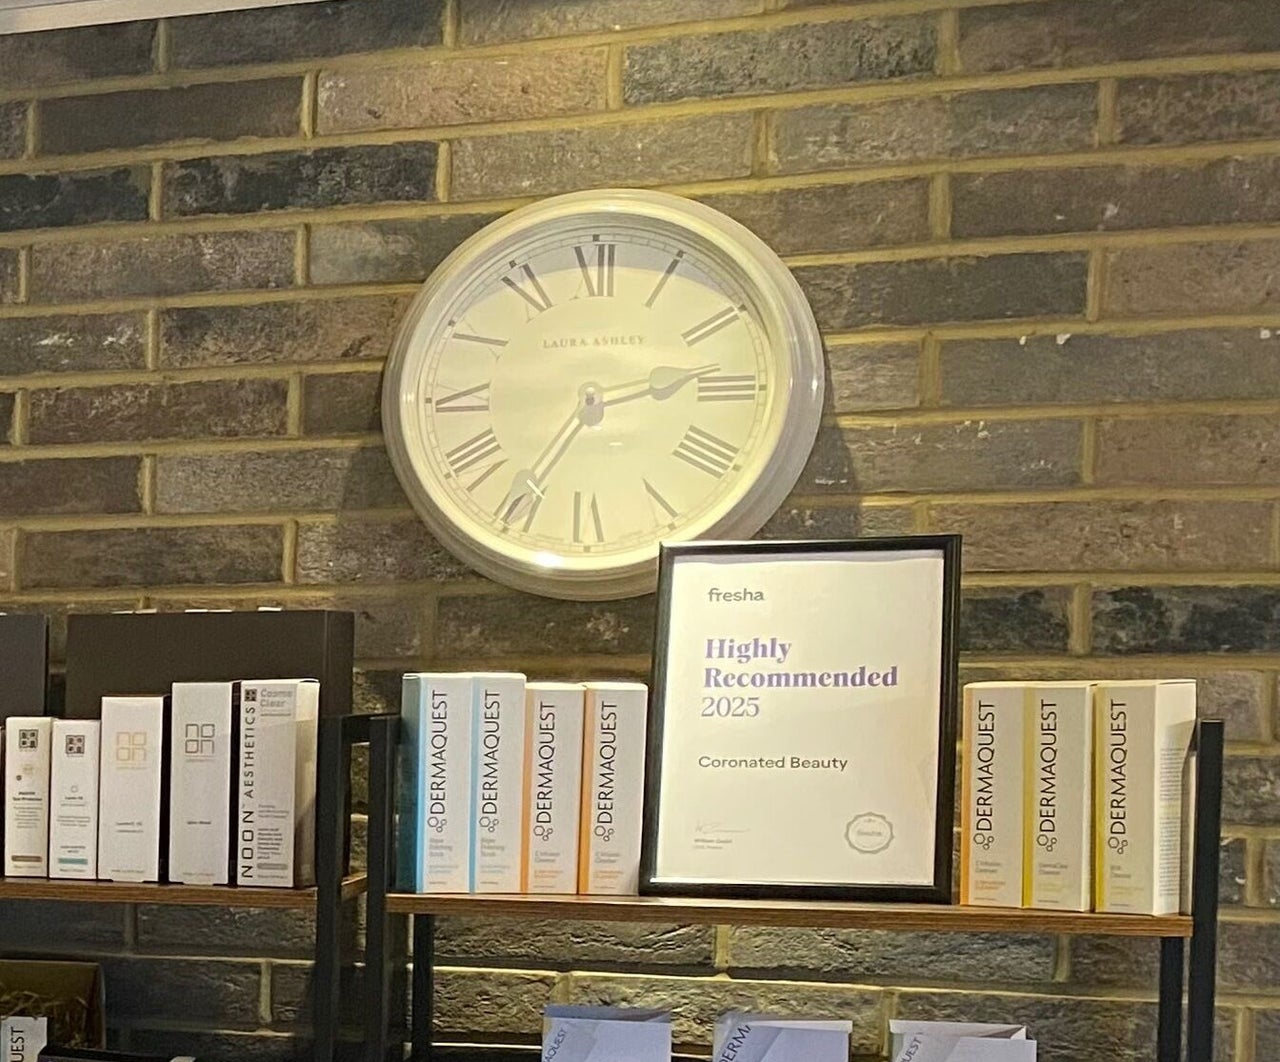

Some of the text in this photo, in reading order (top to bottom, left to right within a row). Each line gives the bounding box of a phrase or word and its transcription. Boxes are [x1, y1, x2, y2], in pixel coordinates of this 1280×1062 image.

[542, 335, 645, 349] LAURA ASHLEY
[704, 637, 792, 663] Highly
[708, 588, 765, 603] fresha
[700, 697, 760, 718] 2025
[703, 666, 898, 688] Recommended
[242, 706, 256, 878] NOON AESTHETICS
[431, 690, 448, 815] DERMAQUEST
[482, 690, 500, 815] DERMAQUEST
[536, 701, 555, 824] DERMAQUEST
[598, 701, 617, 824] DERMAQUEST
[698, 756, 848, 772] Coronated Beauty
[976, 700, 995, 831] DERMAQUEST
[1040, 698, 1057, 833] DERMAQUEST
[1110, 699, 1127, 835] DERMAQUEST
